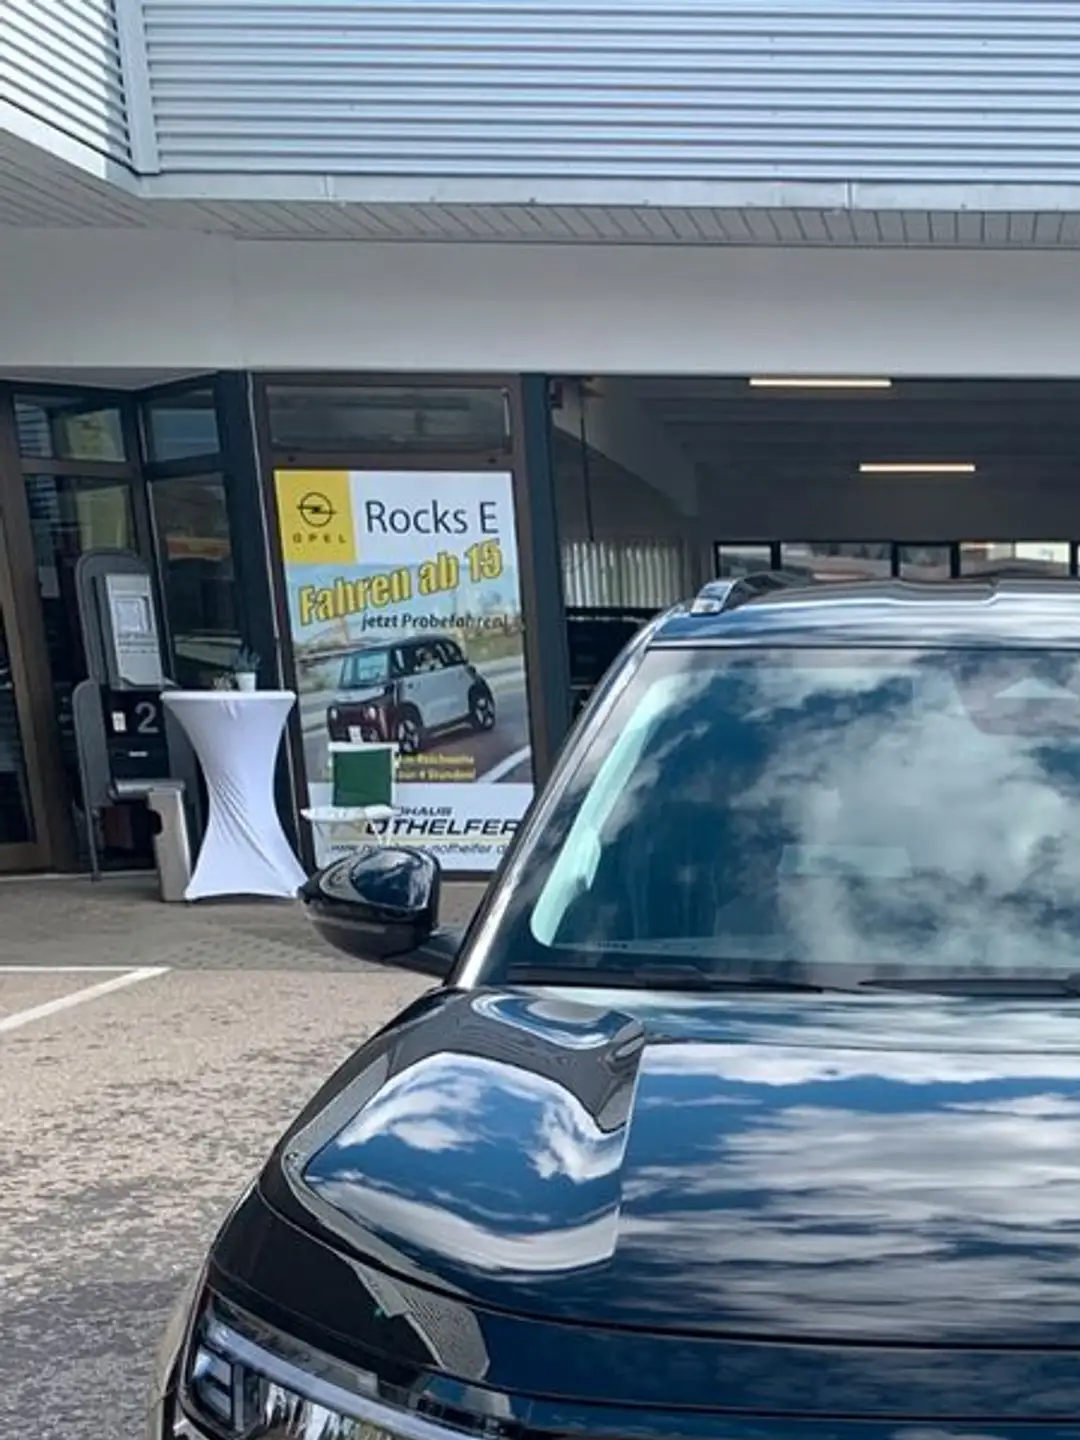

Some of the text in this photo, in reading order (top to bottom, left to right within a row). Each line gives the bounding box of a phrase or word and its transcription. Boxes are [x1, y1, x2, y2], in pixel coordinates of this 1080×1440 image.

[365, 500, 499, 534] Rocks E
[292, 533, 347, 543] OPEL
[299, 538, 503, 626] Fahren ab 15
[361, 612, 398, 631] jetzt
[135, 702, 159, 734] 2
